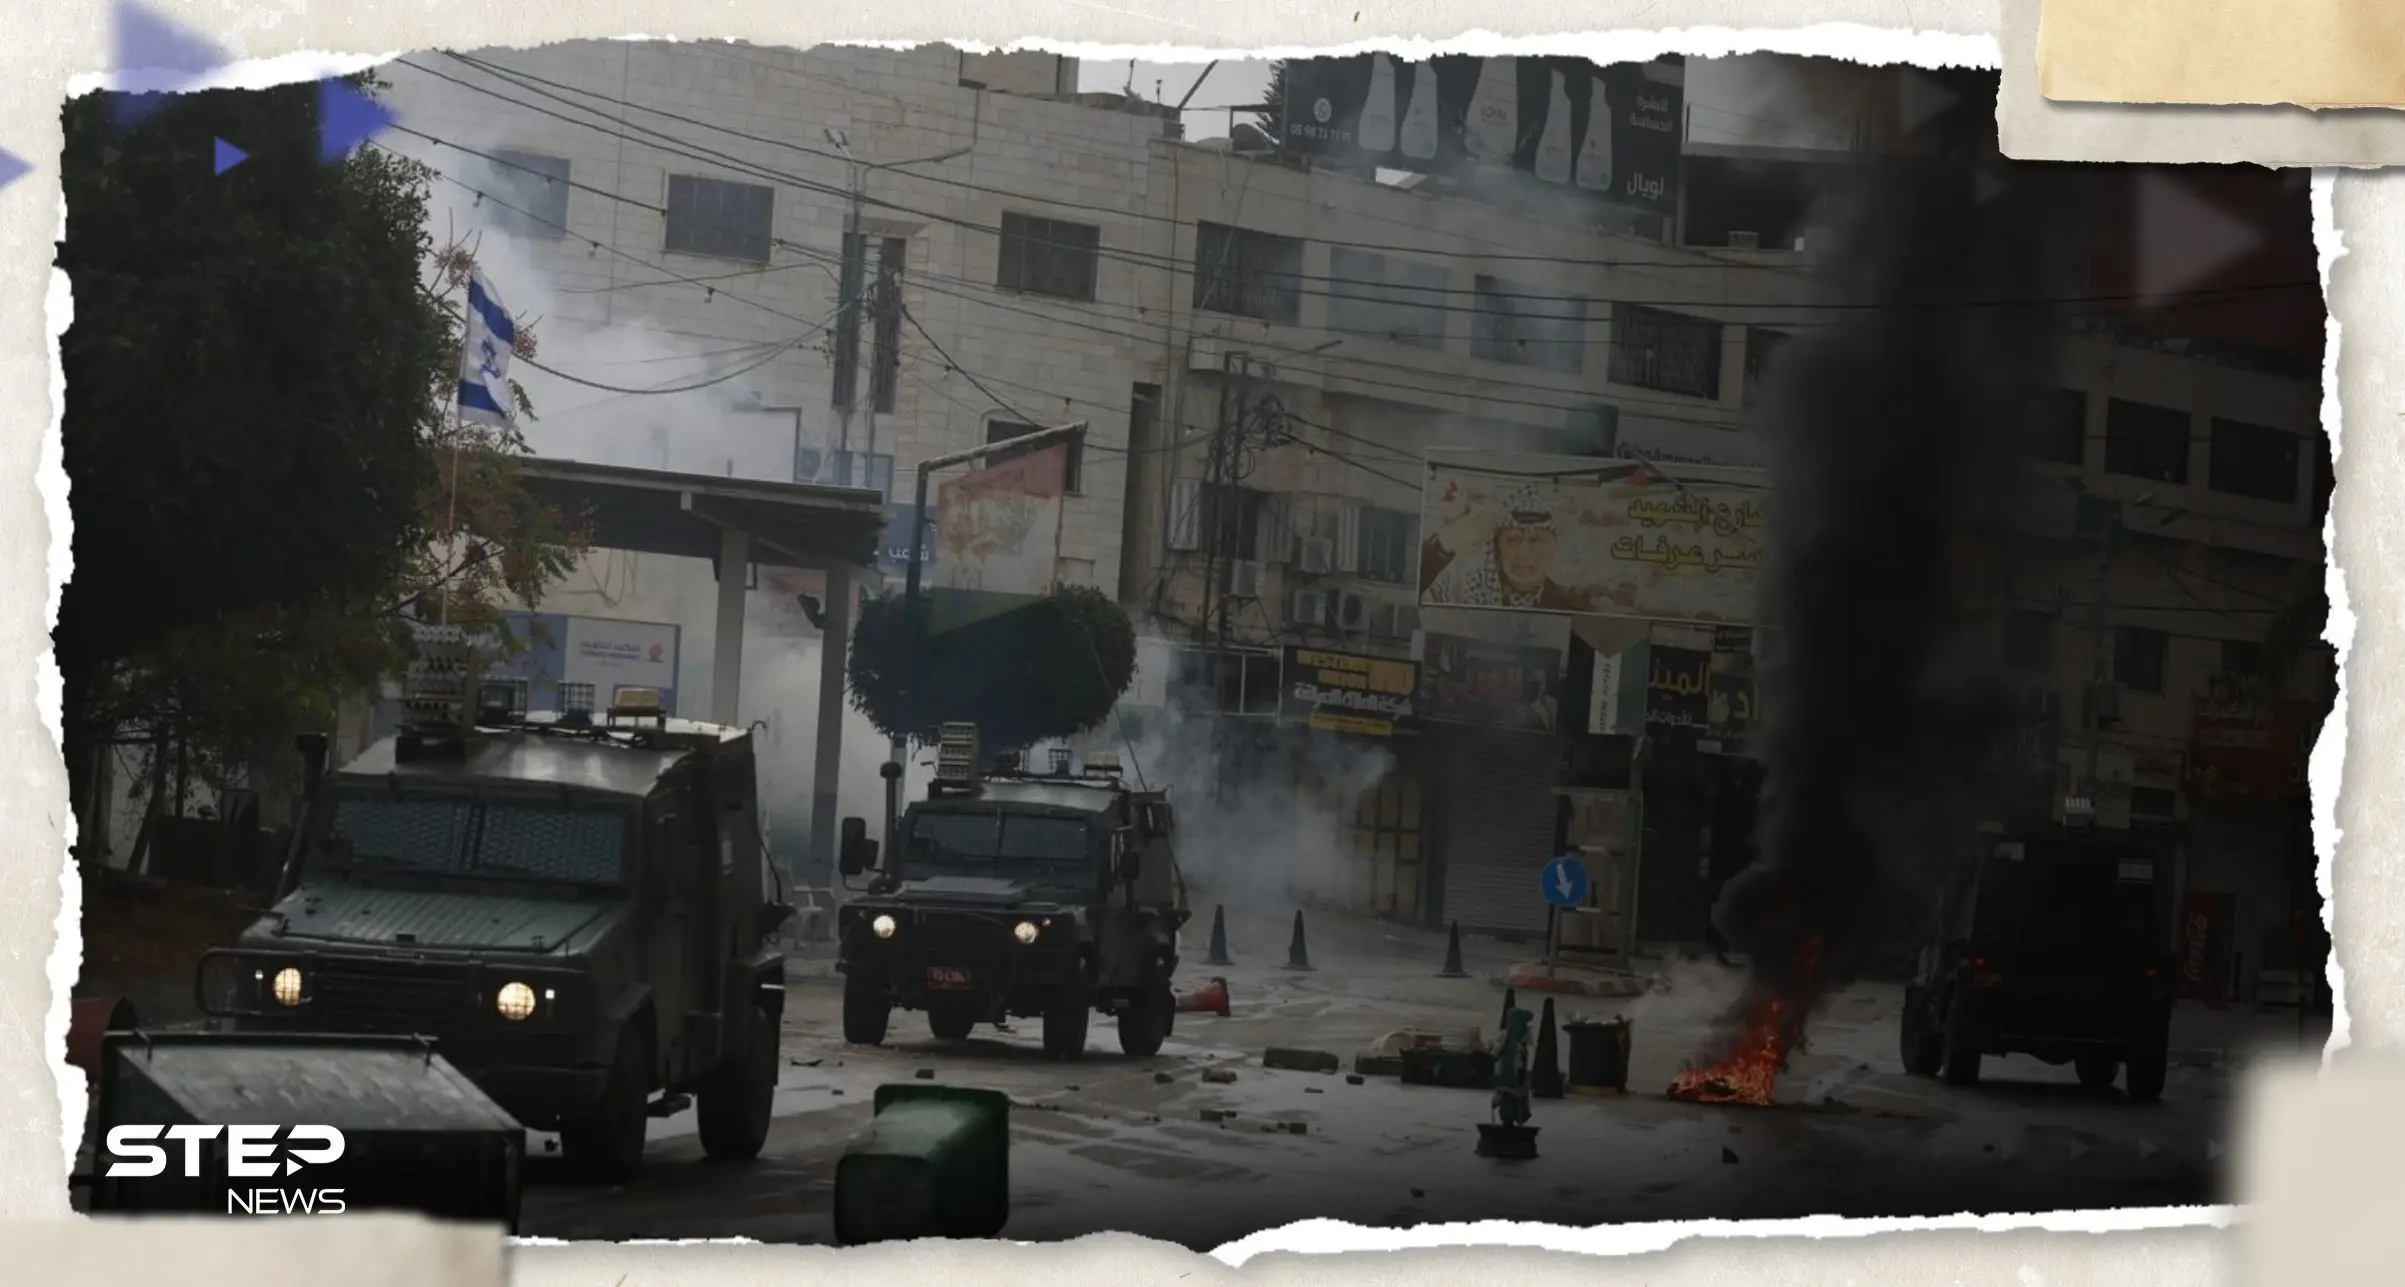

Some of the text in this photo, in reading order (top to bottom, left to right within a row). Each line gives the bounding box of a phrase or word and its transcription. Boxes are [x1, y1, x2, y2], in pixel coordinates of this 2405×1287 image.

[1626, 170, 1665, 200] لويال
[1627, 498, 1710, 532] الشهيد
[1610, 534, 1705, 571] عرفات
